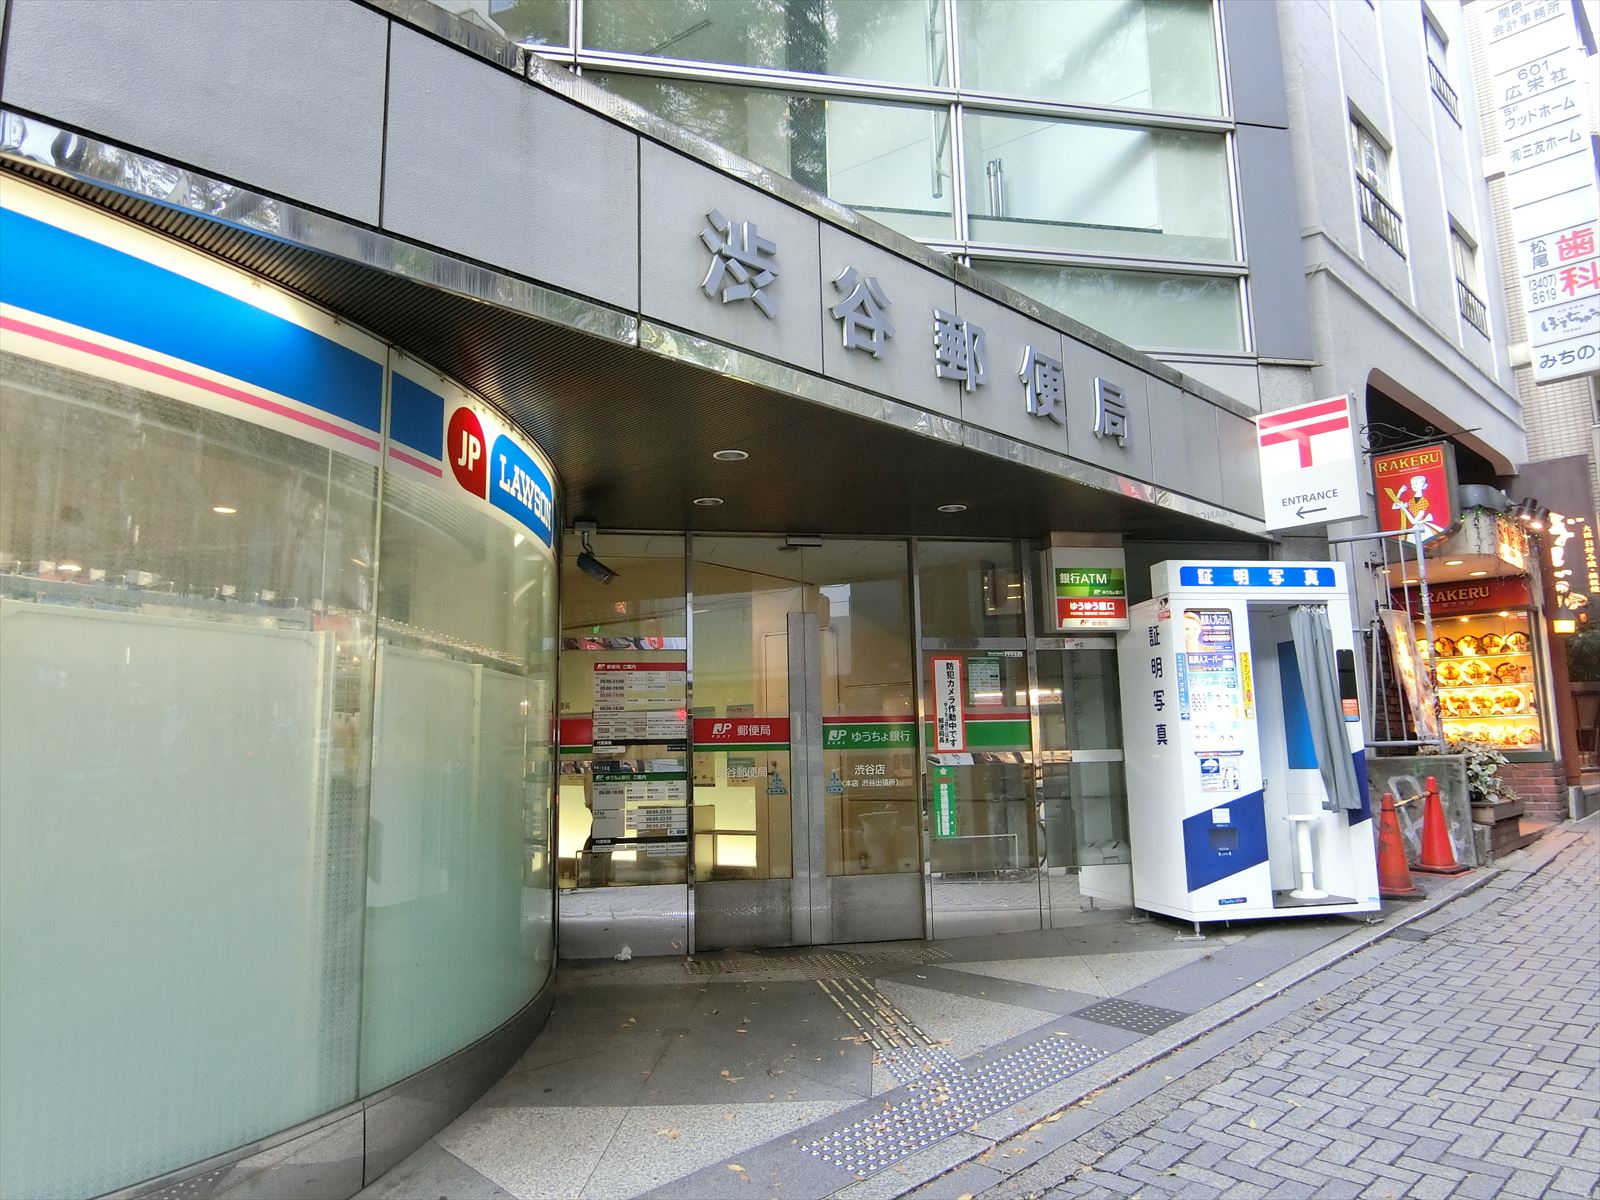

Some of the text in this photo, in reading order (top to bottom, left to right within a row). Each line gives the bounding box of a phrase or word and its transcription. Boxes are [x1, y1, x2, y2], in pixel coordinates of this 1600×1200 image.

[1493, 2, 1560, 37] 会計事務所
[1517, 60, 1548, 80] 601
[1505, 68, 1568, 101] 広栄社
[1505, 97, 1576, 130] ウッドホーム
[1530, 240, 1549, 270] 松尾
[1529, 274, 1557, 292] (3407)
[1532, 288, 1556, 305] 8619
[698, 206, 1132, 448] 渋谷郵便局
[1540, 345, 1600, 369] みちの
[457, 430, 482, 472] JP
[1378, 452, 1440, 473] RAKERU
[499, 453, 552, 533] LAWSON
[1281, 488, 1338, 507] ENTRANCE
[1059, 573, 1108, 584] 銀行ATM
[1197, 568, 1320, 586] 証明写真
[1148, 625, 1168, 745] 証明写真
[946, 662, 958, 748] 防犯カメラ作動中です
[737, 724, 771, 736] 郵便局
[851, 731, 912, 743] ゆうちょ銀行
[854, 764, 886, 776] 渋谷店
